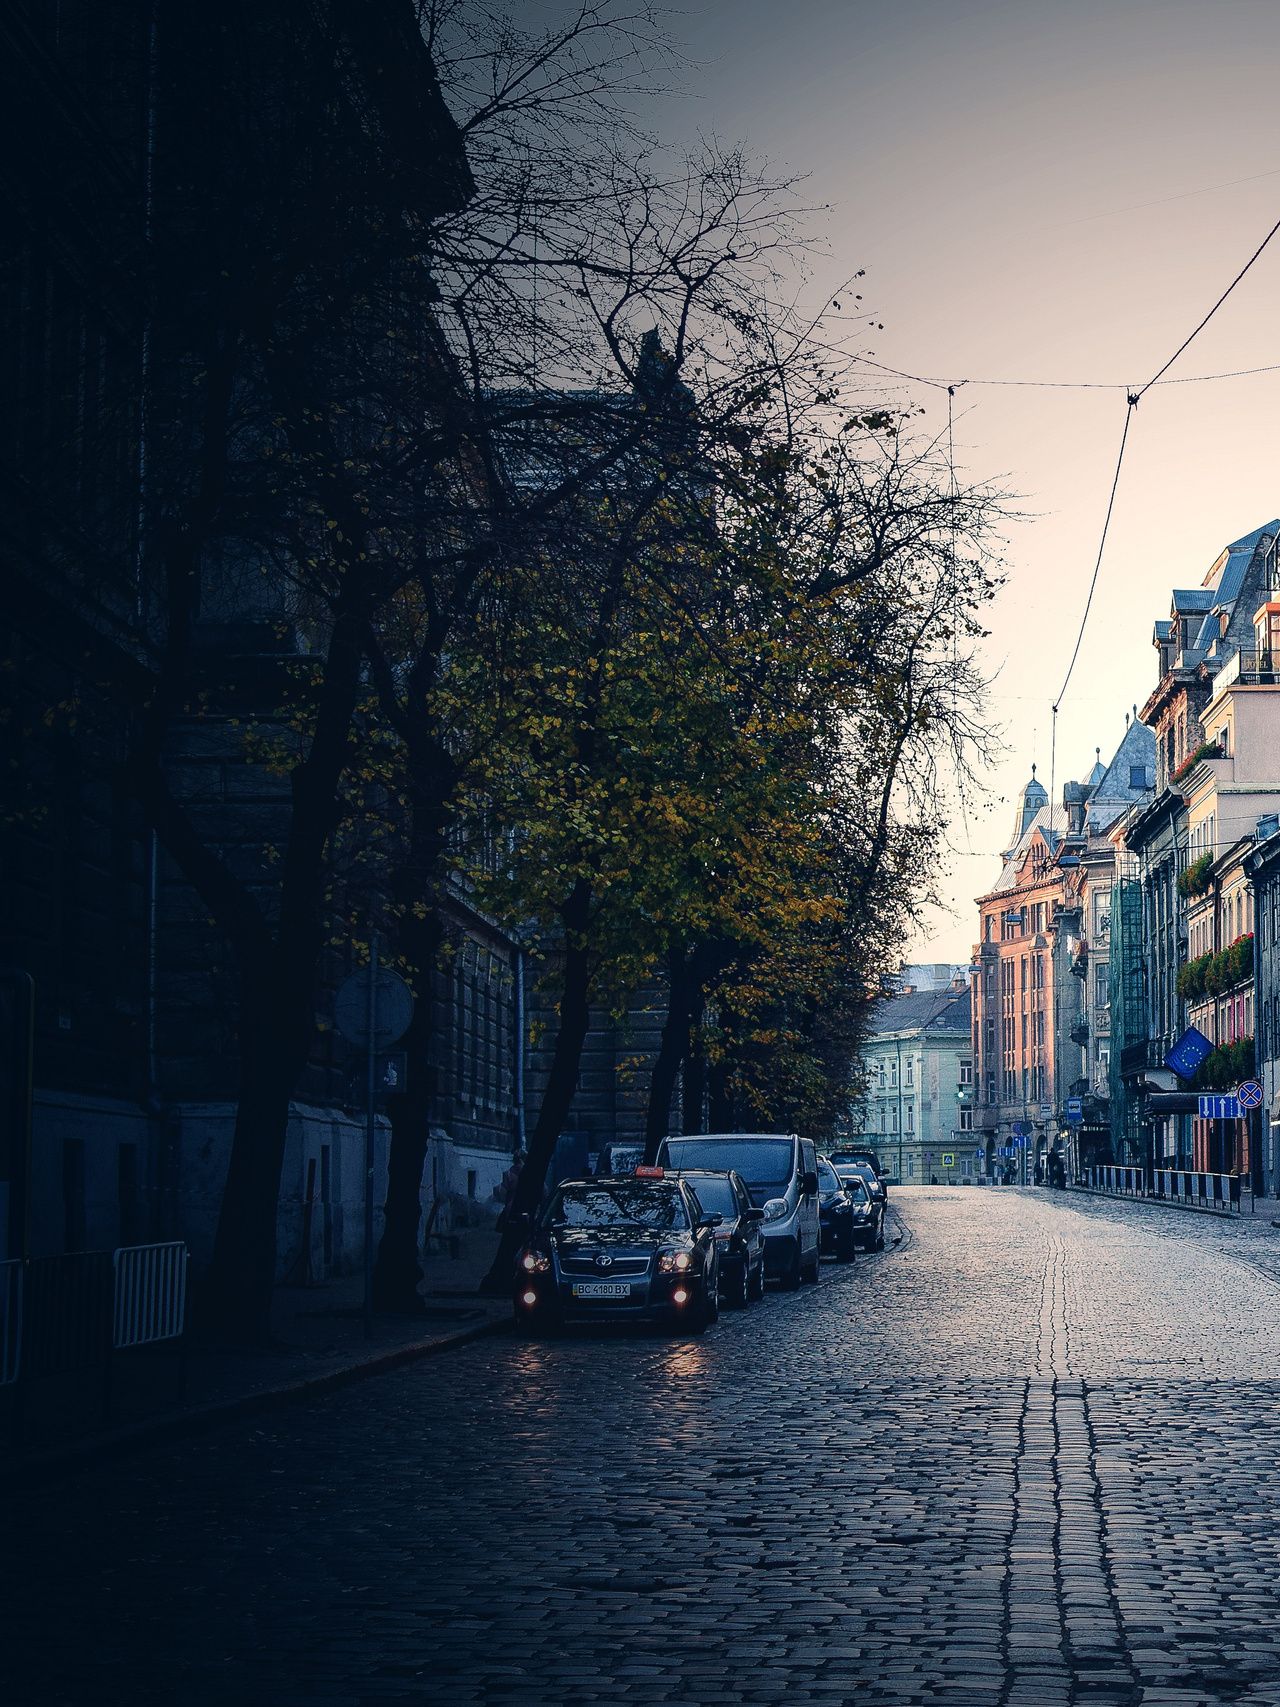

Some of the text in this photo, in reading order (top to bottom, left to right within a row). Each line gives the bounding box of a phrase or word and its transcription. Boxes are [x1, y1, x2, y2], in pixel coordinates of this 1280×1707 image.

[578, 1285, 628, 1294] BC 4180 BX
